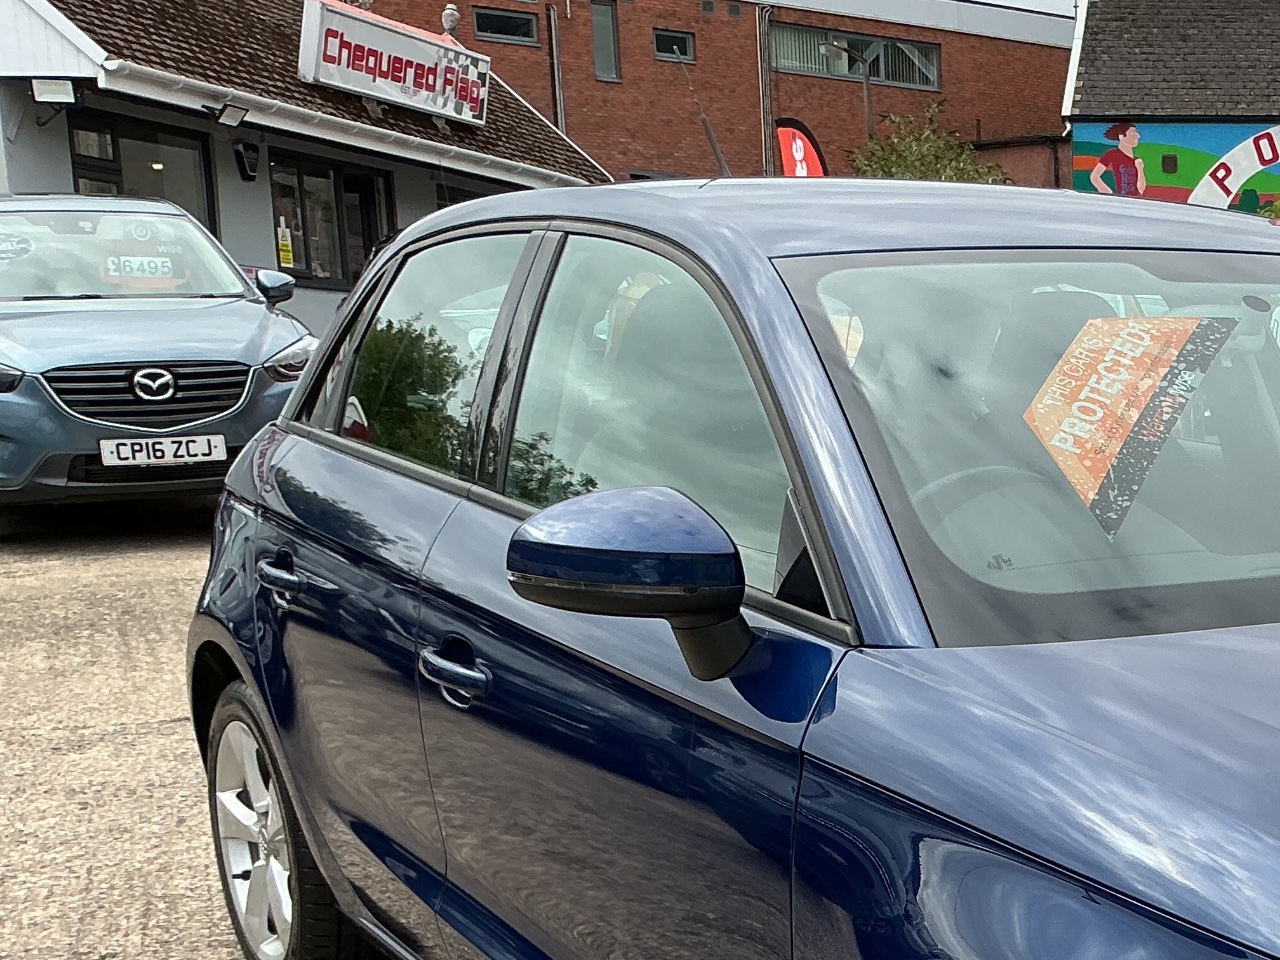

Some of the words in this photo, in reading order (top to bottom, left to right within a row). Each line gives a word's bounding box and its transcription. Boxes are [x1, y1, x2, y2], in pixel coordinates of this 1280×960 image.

[322, 27, 438, 94] Chequered
[441, 64, 482, 115] Flag
[106, 256, 174, 277] £6495
[1080, 336, 1104, 351] IS
[1063, 347, 1098, 377] CAR
[1042, 376, 1077, 406] THIS
[115, 441, 166, 461] CP16
[170, 438, 213, 459] ZCJ
